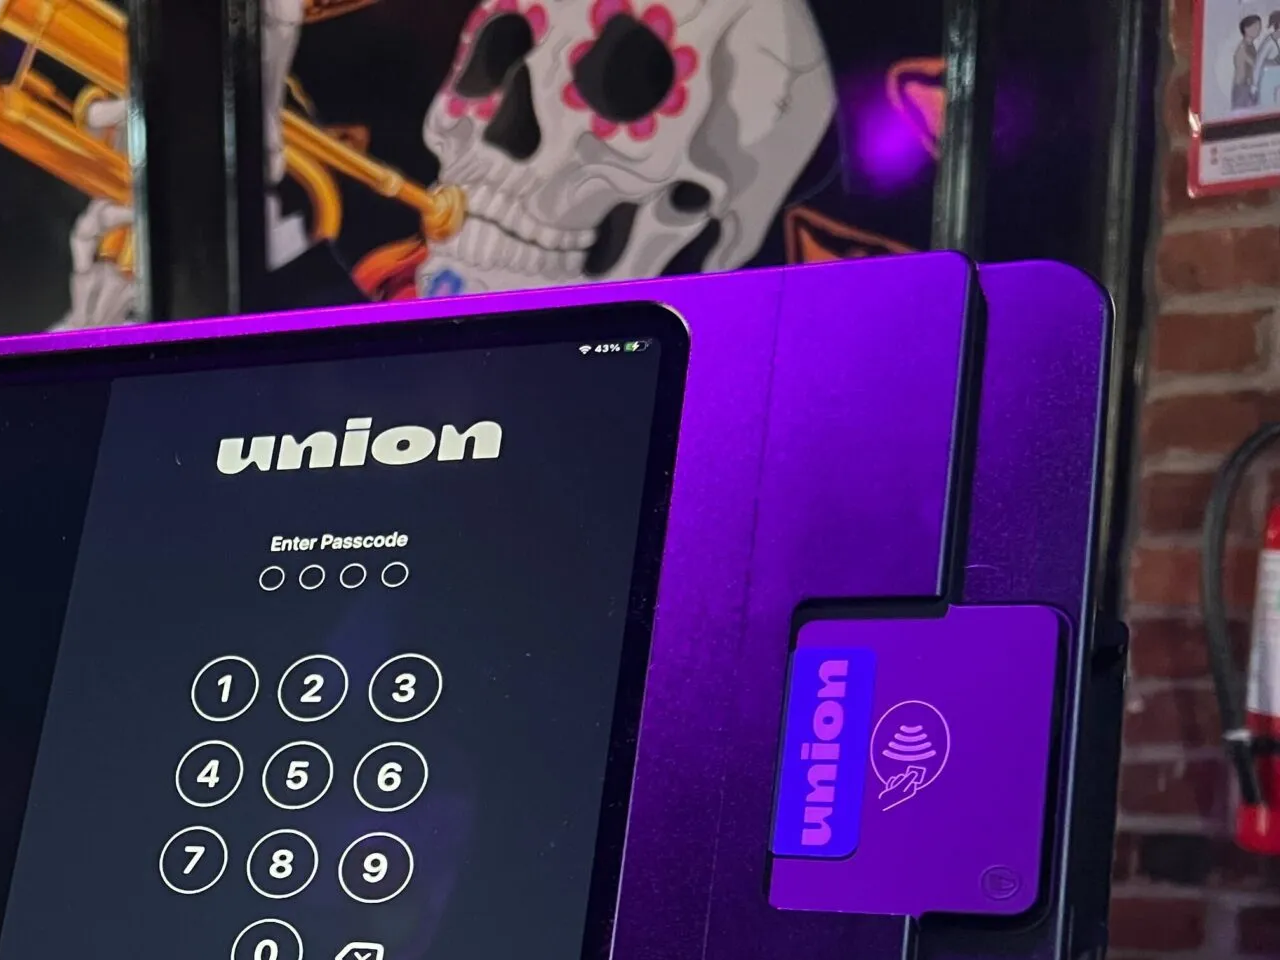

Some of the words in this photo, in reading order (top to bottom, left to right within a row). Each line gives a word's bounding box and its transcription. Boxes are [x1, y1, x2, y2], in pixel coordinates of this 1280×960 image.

[594, 343, 621, 353] 43%
[216, 416, 503, 475] union
[270, 535, 318, 552] Enter
[320, 531, 409, 551] Passcode
[217, 674, 233, 703] 1
[300, 673, 325, 703] 2
[391, 673, 417, 703] 3
[800, 660, 849, 846] union
[196, 759, 220, 788] 4
[285, 760, 310, 790] 5
[376, 762, 403, 792] 6
[183, 845, 206, 874] 7
[269, 849, 294, 879] 8
[362, 852, 388, 883] 9
